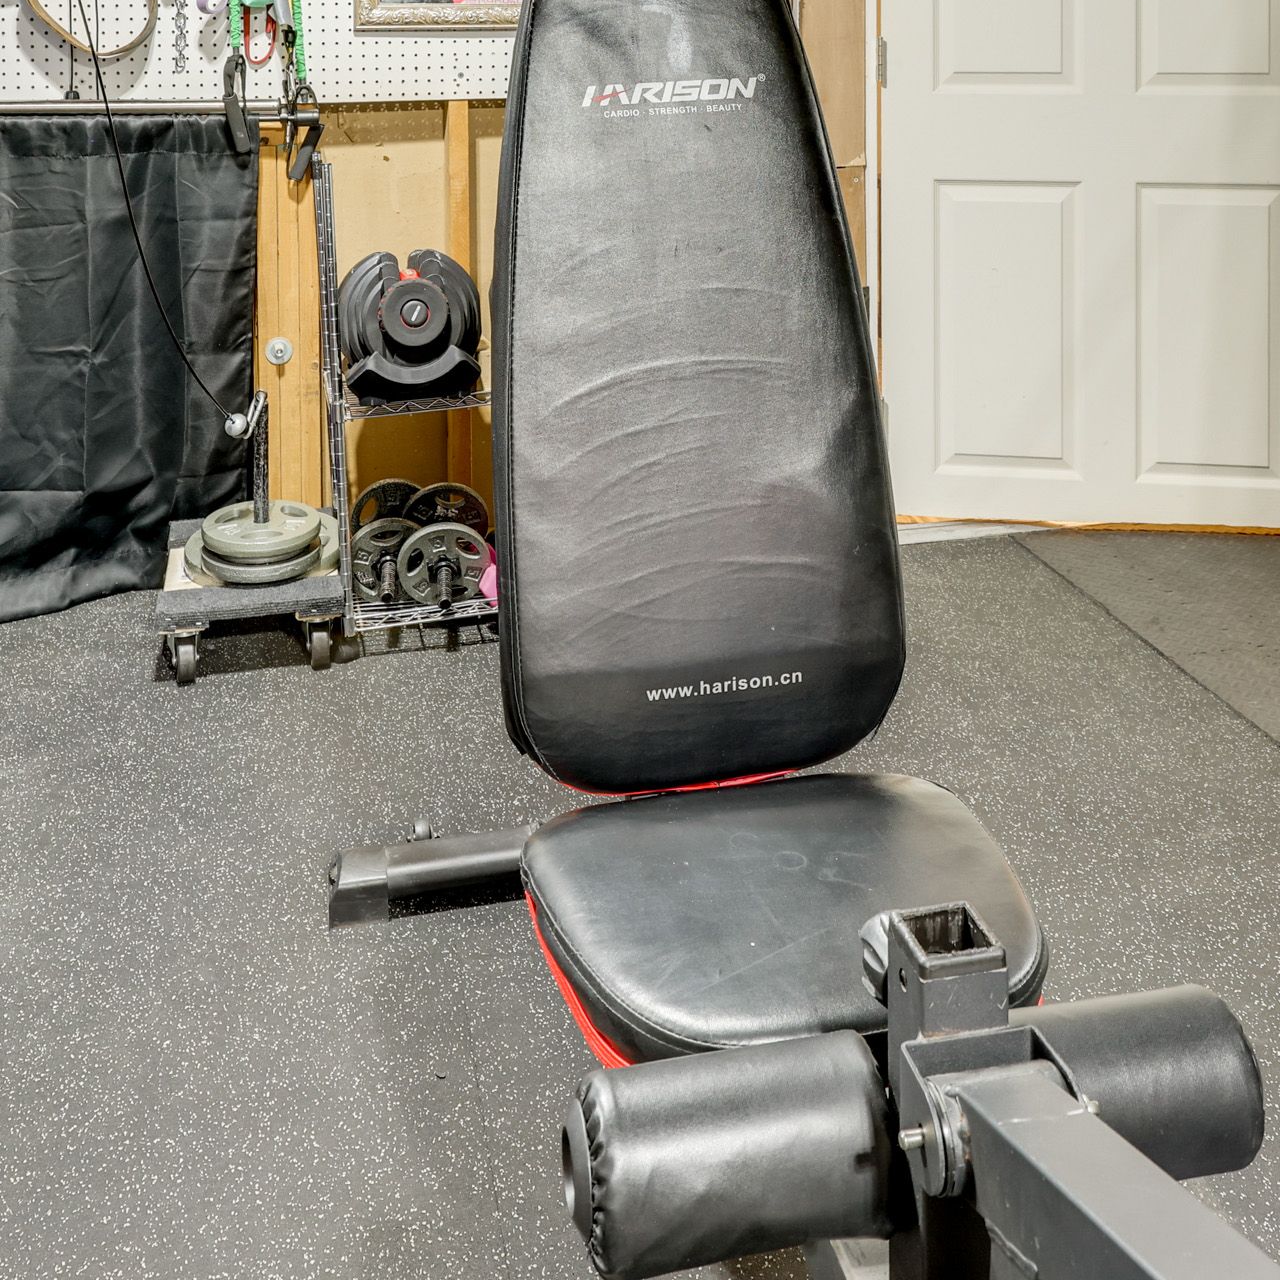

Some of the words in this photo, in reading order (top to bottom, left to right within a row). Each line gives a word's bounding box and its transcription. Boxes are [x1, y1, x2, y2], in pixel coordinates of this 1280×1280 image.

[603, 108, 640, 118] CARDIO
[648, 105, 697, 116] STRENGTH
[706, 103, 742, 113] BEAUTY
[645, 671, 803, 702] www.harison.cn
